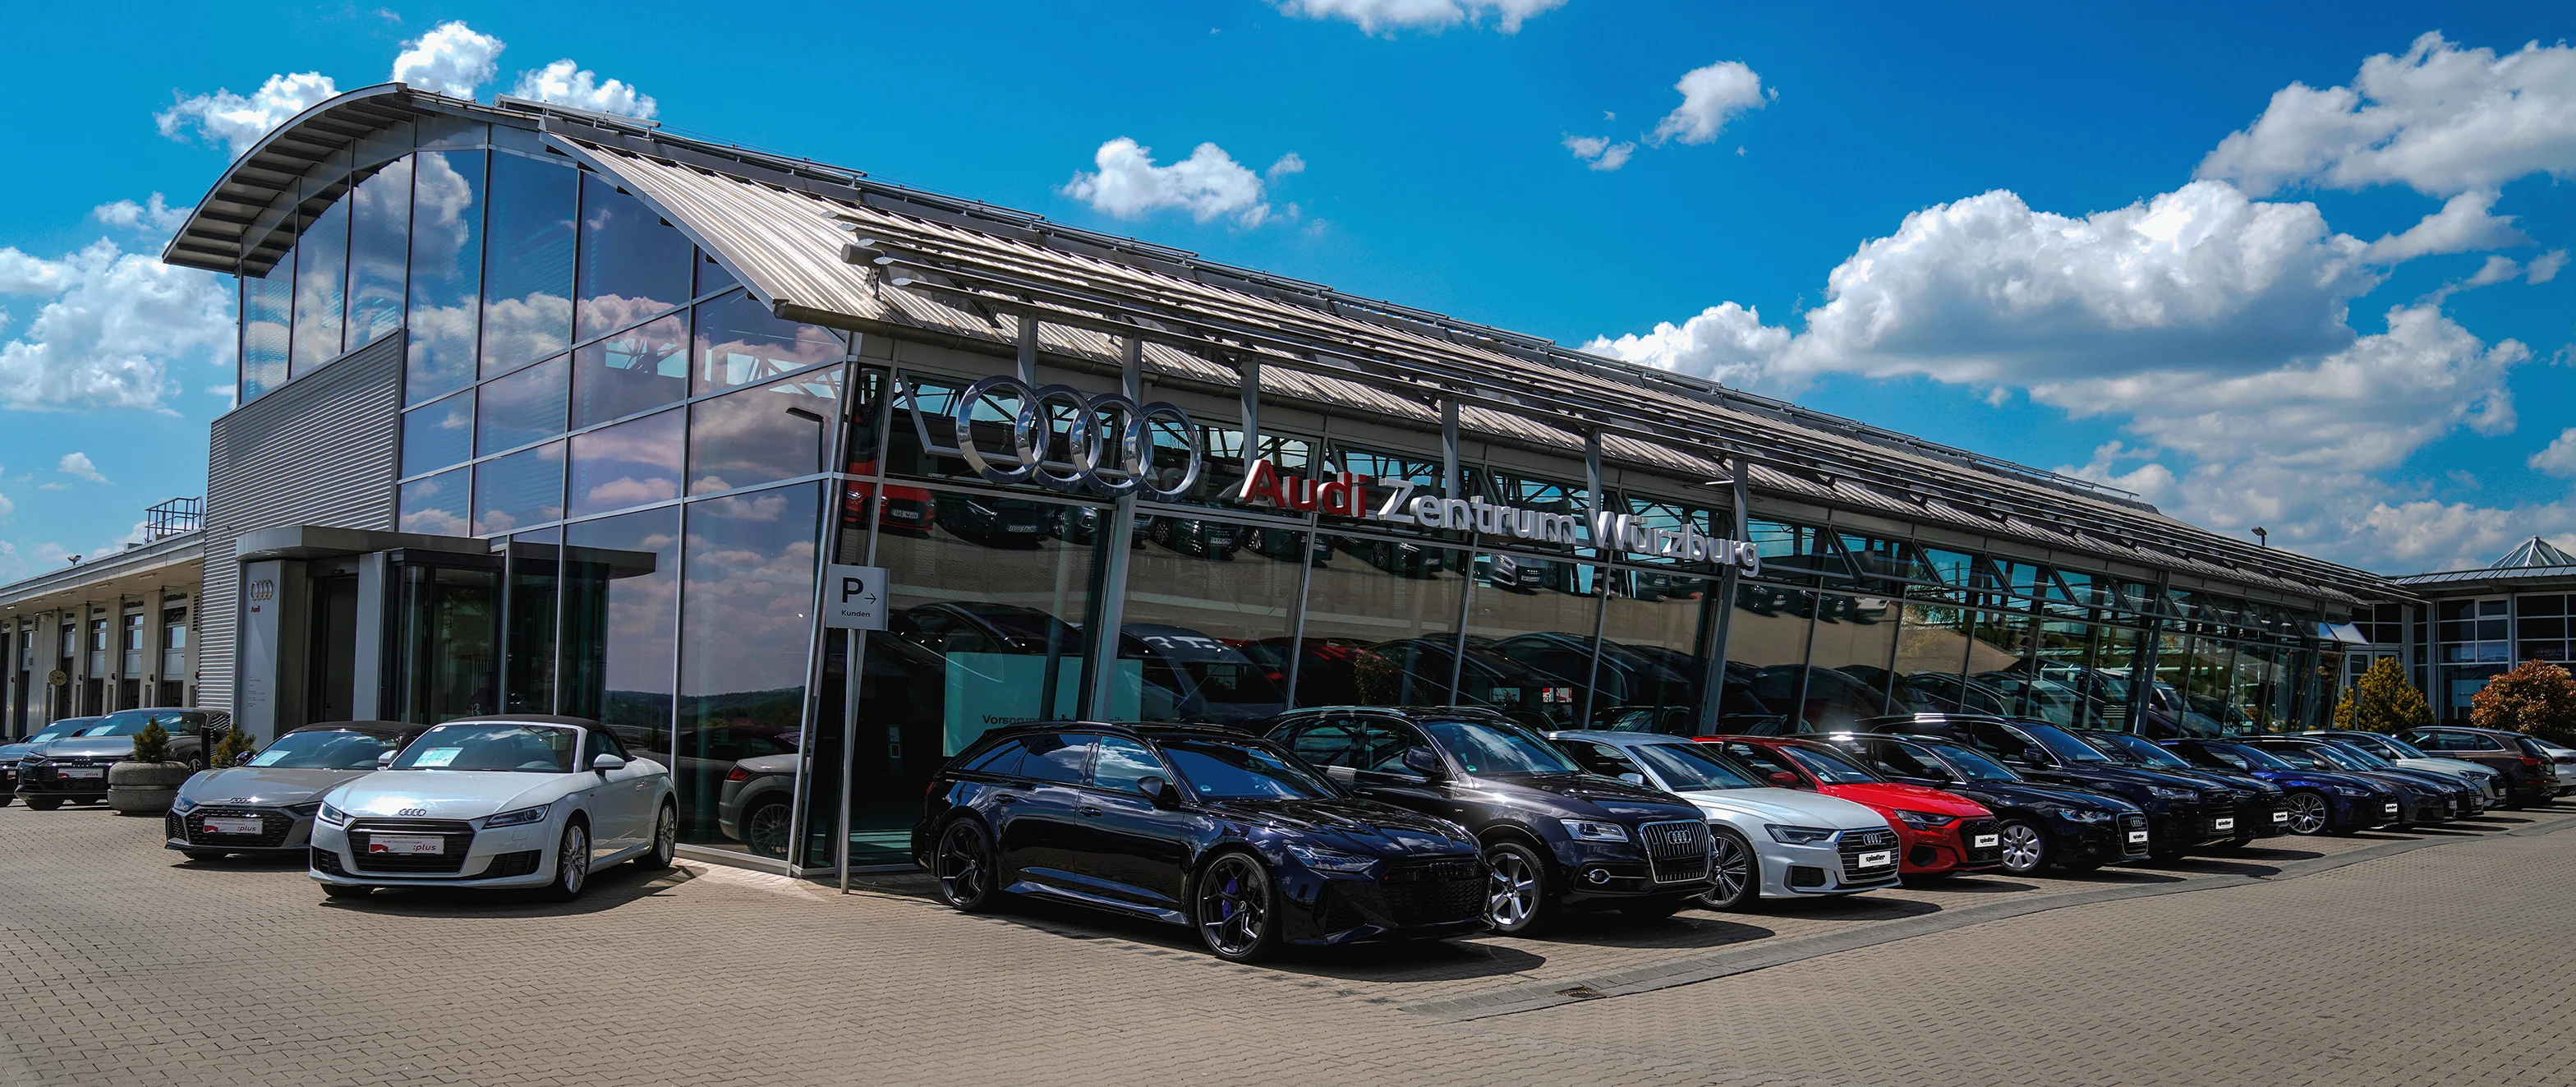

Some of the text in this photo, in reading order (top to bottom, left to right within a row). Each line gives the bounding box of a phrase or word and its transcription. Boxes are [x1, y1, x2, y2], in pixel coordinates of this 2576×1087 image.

[1239, 458, 1760, 578] Audi Zentrum Würzburg
[842, 577, 864, 603] P
[982, 714, 1041, 724] Vorsprun
[1865, 854, 1885, 863] spindler
